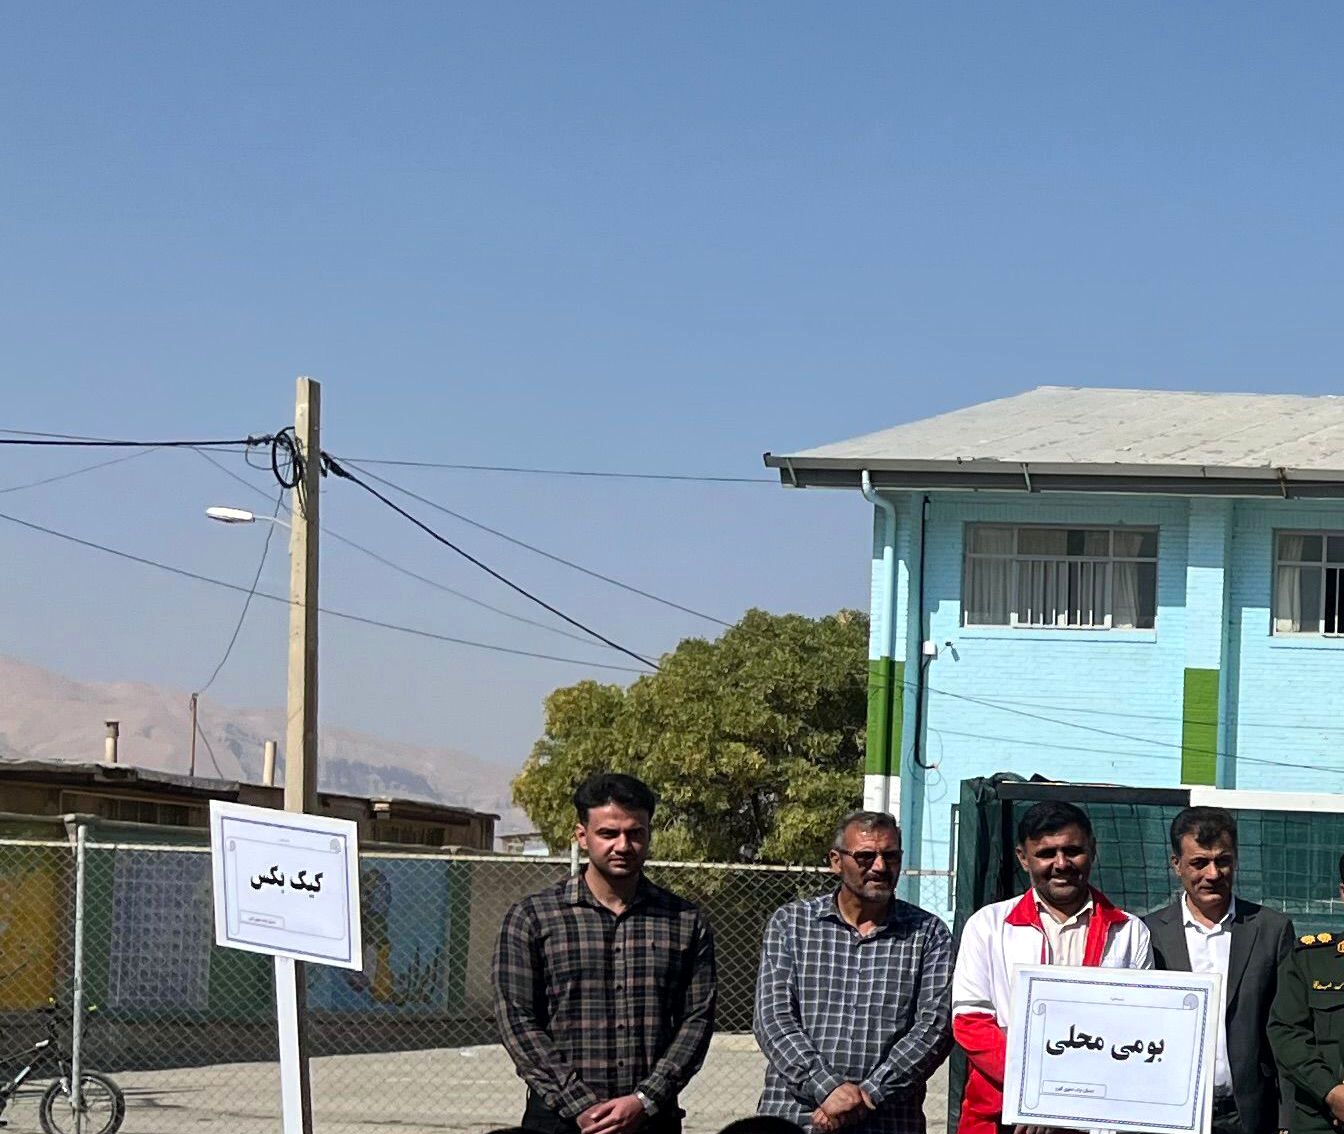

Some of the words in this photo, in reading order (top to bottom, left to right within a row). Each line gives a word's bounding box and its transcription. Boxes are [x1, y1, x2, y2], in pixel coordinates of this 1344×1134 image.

[250, 864, 285, 893] بکس
[1046, 1024, 1105, 1056] محلی
[1111, 1038, 1165, 1063] بومی
